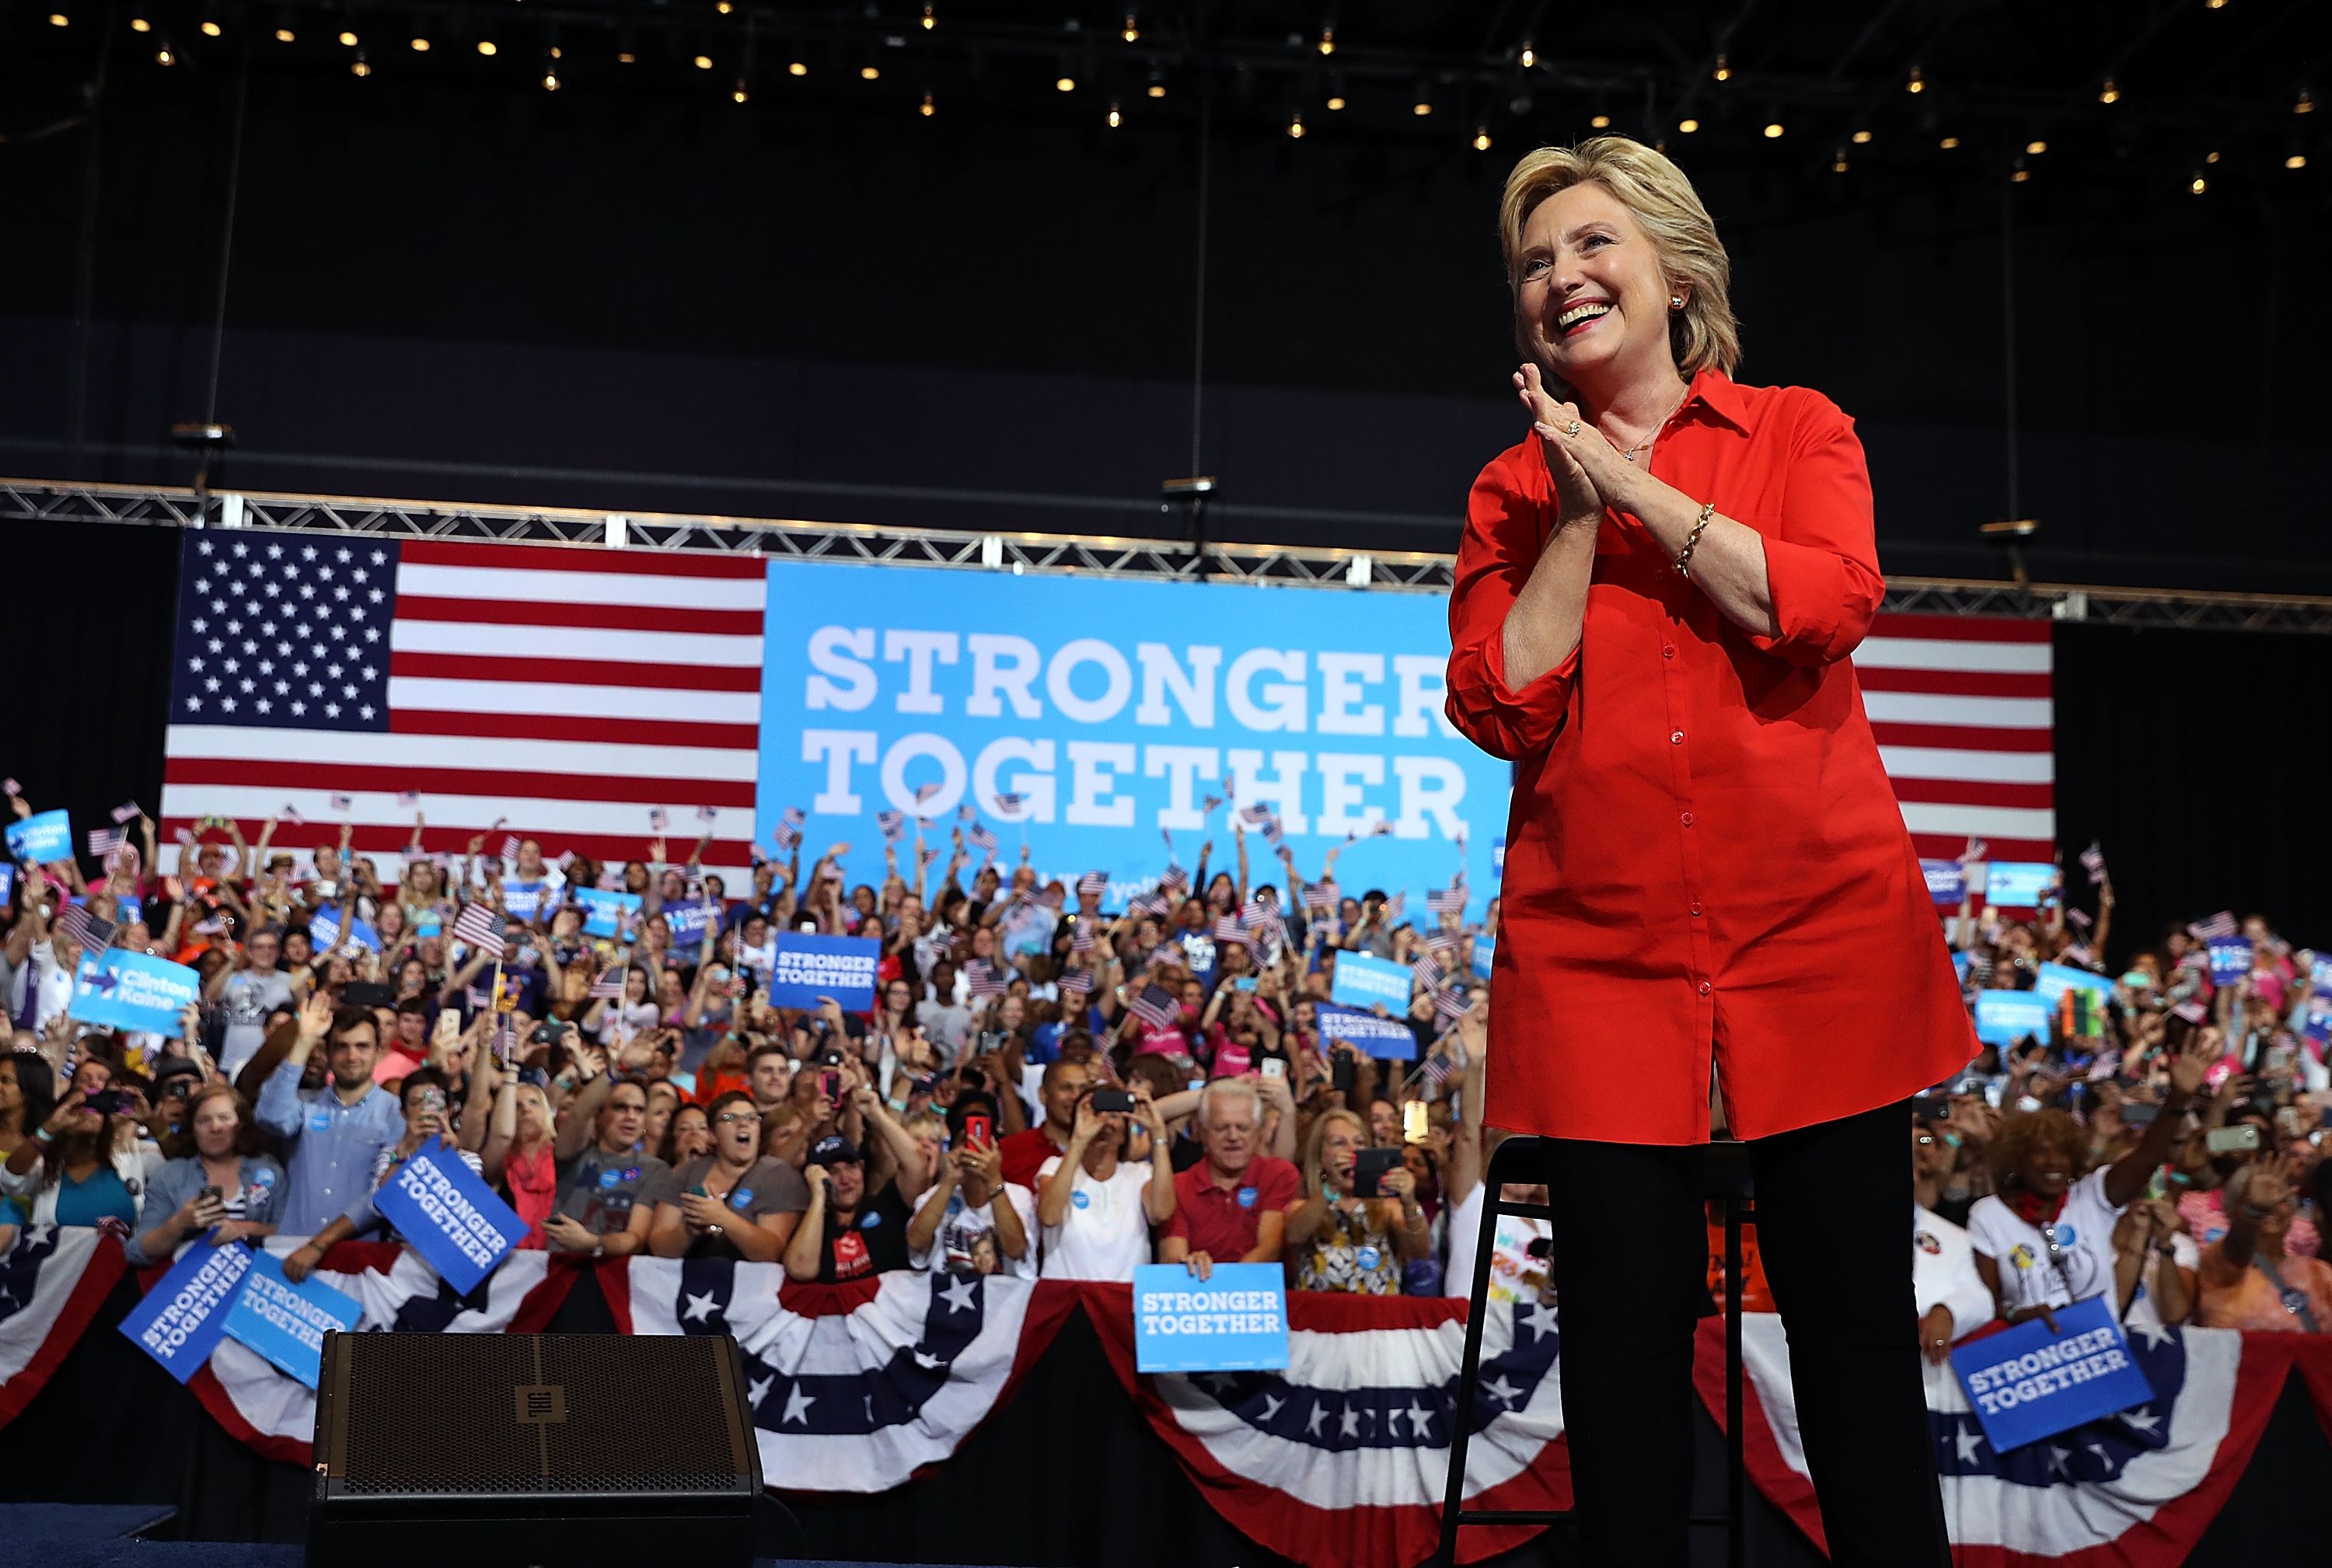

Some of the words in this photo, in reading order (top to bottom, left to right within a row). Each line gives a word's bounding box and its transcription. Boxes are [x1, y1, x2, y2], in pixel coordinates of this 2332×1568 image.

[805, 625, 1464, 739] STRONGER
[801, 728, 1469, 840] TOGETHER
[121, 969, 192, 1001] Clinton
[776, 967, 874, 989] TOGETHER
[778, 951, 876, 973] STRONGER
[117, 985, 175, 1011] Kaine
[397, 1168, 493, 1269] TOGETHER
[411, 1155, 508, 1255] STRONGER
[141, 1243, 240, 1349] STRONGER
[156, 1252, 253, 1359] TOGETHER
[243, 1287, 323, 1354] TOGETHE
[1142, 1291, 1279, 1313] STRONGER
[1143, 1313, 1281, 1336] TOGETHER
[1967, 1327, 2119, 1395] STRONGER
[1977, 1348, 2131, 1416] TOGETHER
